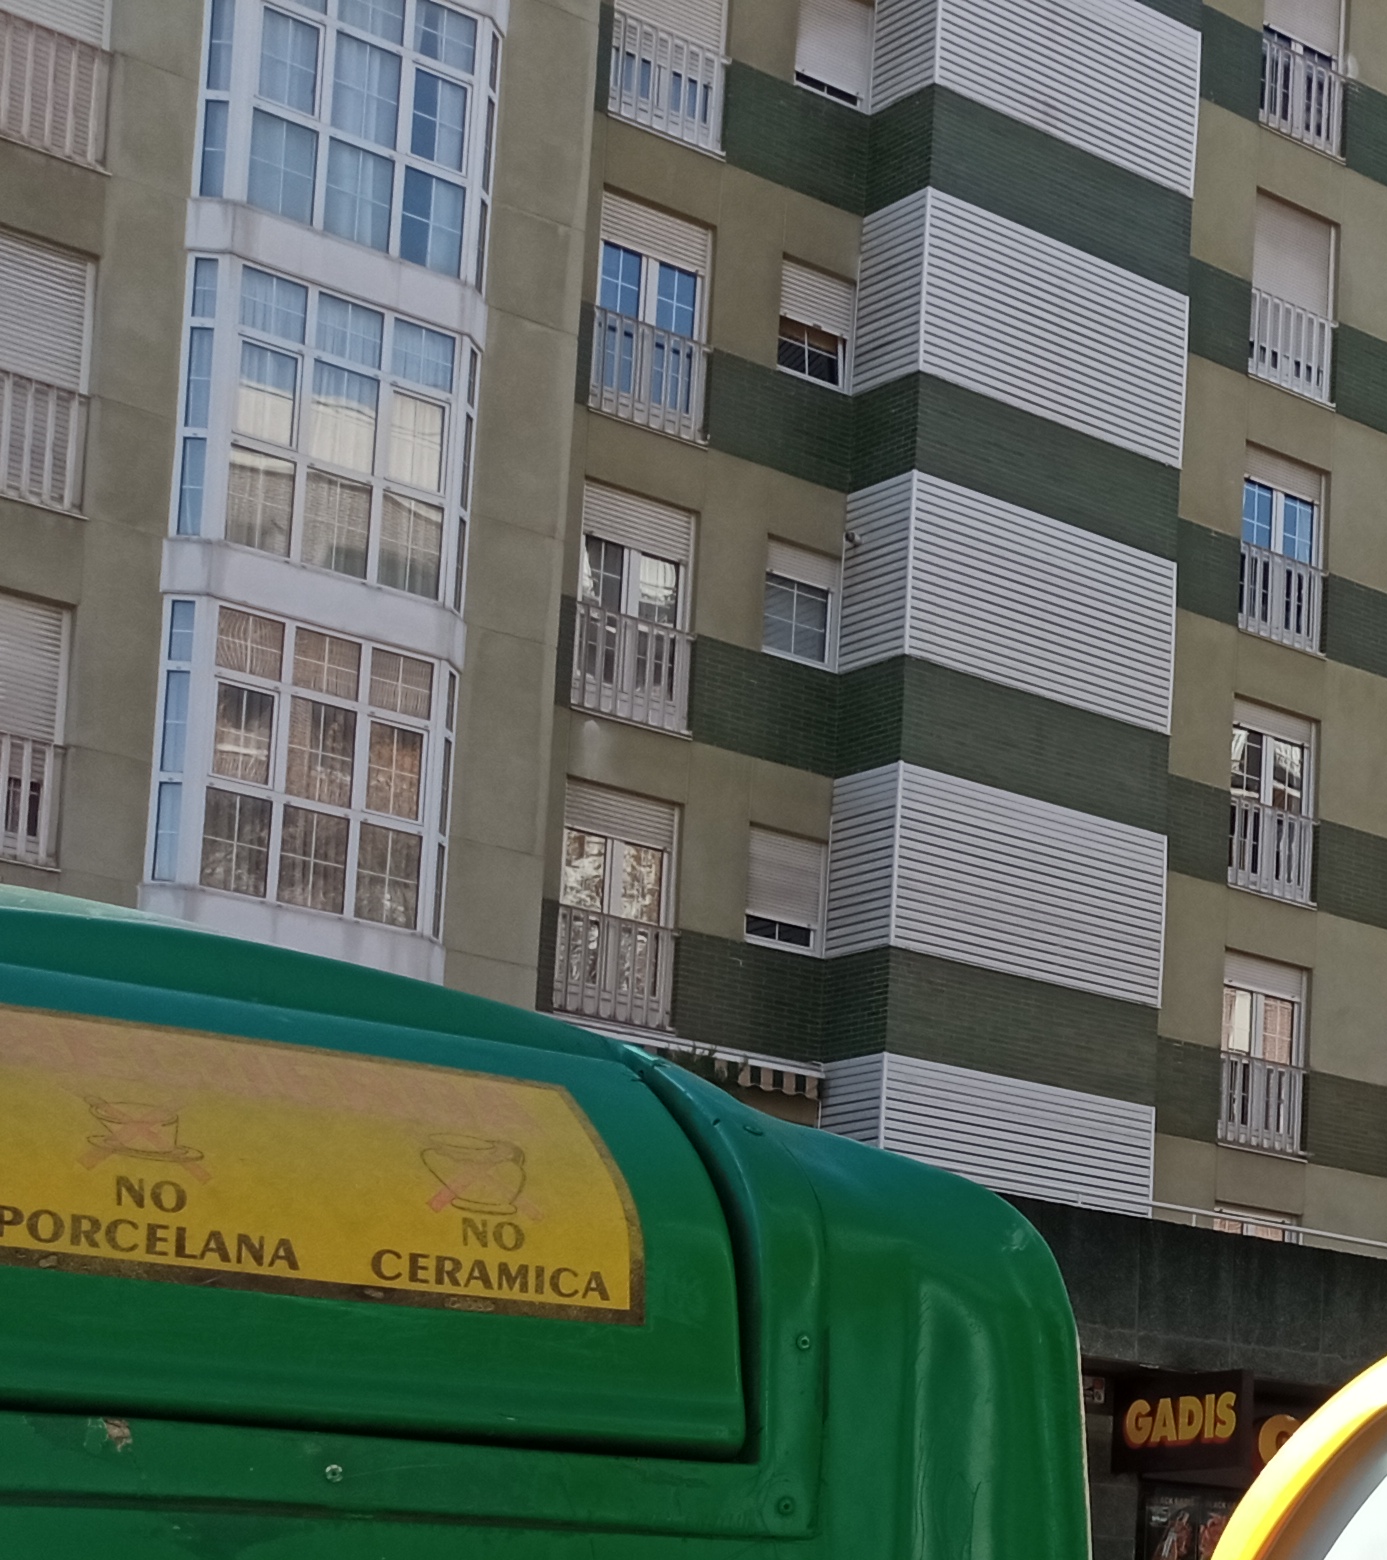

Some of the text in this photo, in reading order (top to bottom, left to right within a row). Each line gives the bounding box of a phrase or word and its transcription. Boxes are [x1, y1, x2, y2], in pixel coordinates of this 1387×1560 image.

[115, 1175, 188, 1214] NO
[0, 1205, 611, 1301] PORCELANA CERAMICA
[461, 1216, 526, 1251] NO
[1124, 1391, 1237, 1446] GADIS
